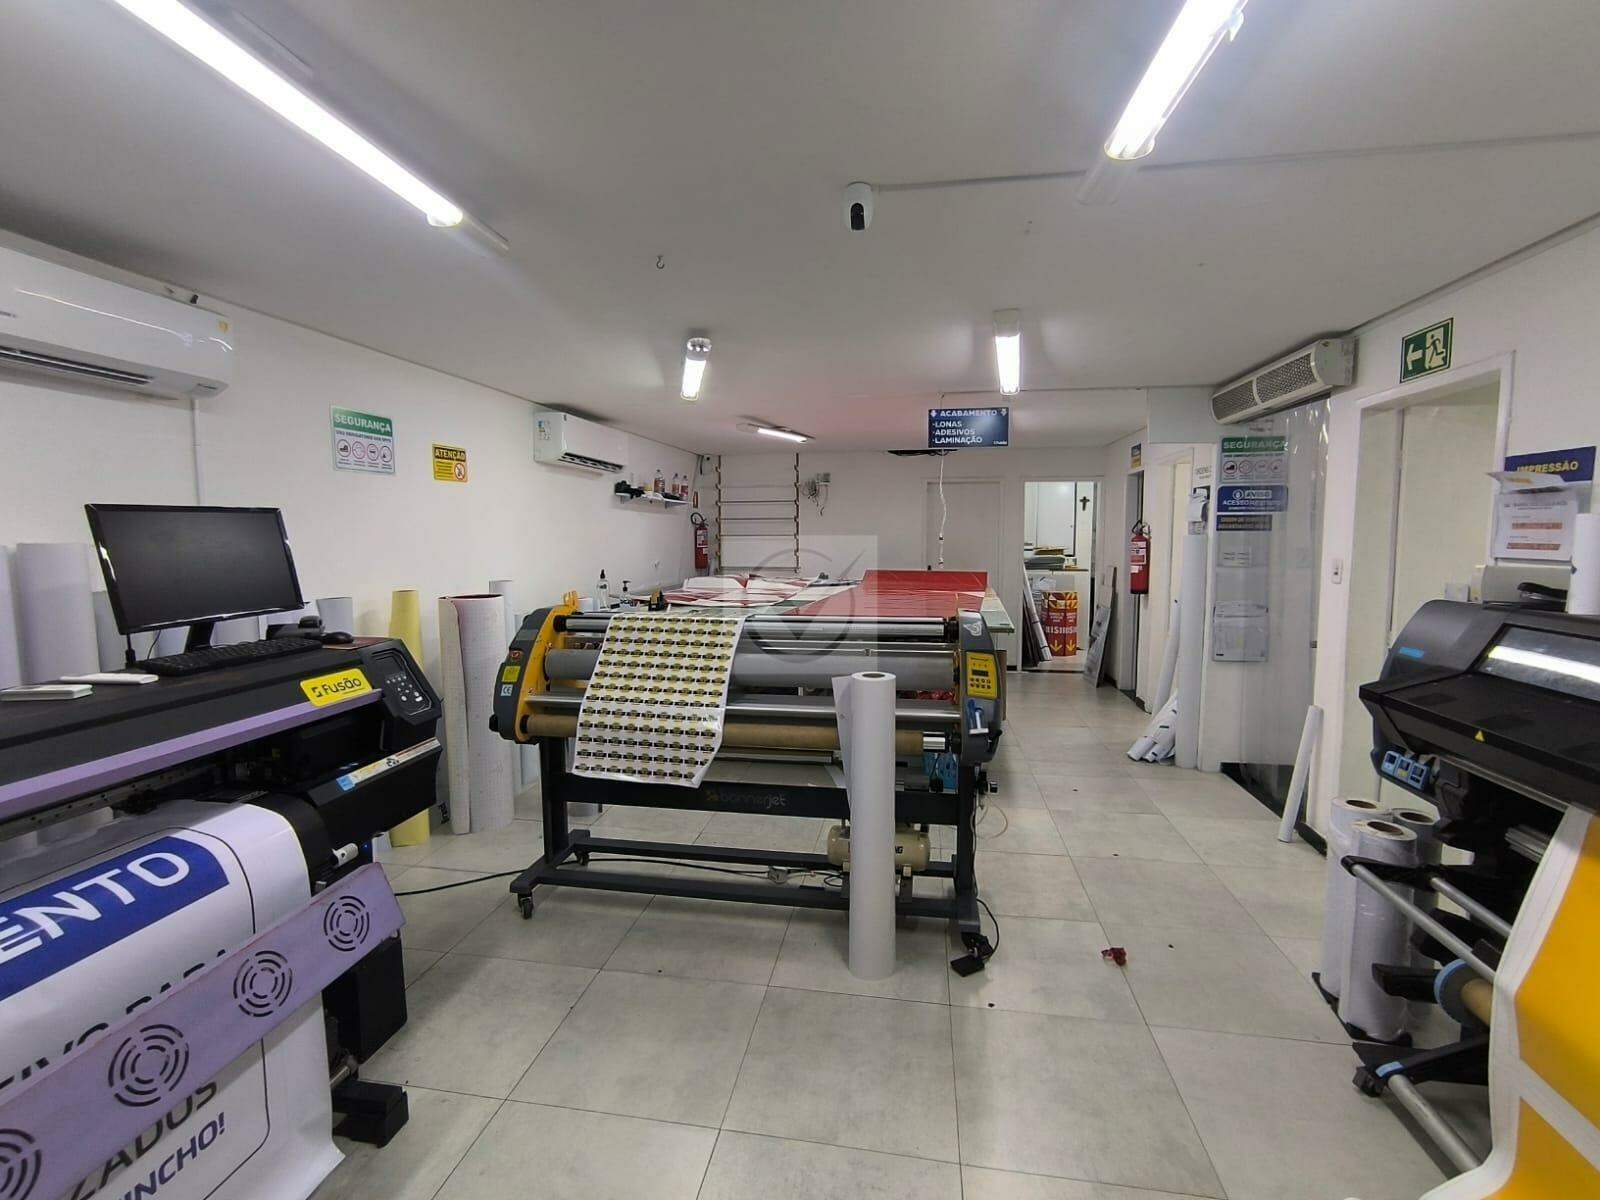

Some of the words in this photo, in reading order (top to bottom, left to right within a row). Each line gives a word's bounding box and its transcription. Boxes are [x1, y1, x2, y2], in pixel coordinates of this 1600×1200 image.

[335, 415, 391, 434] SEGURANÇA
[935, 420, 962, 428] LONAS
[935, 436, 983, 444] LAMINAÇÃO
